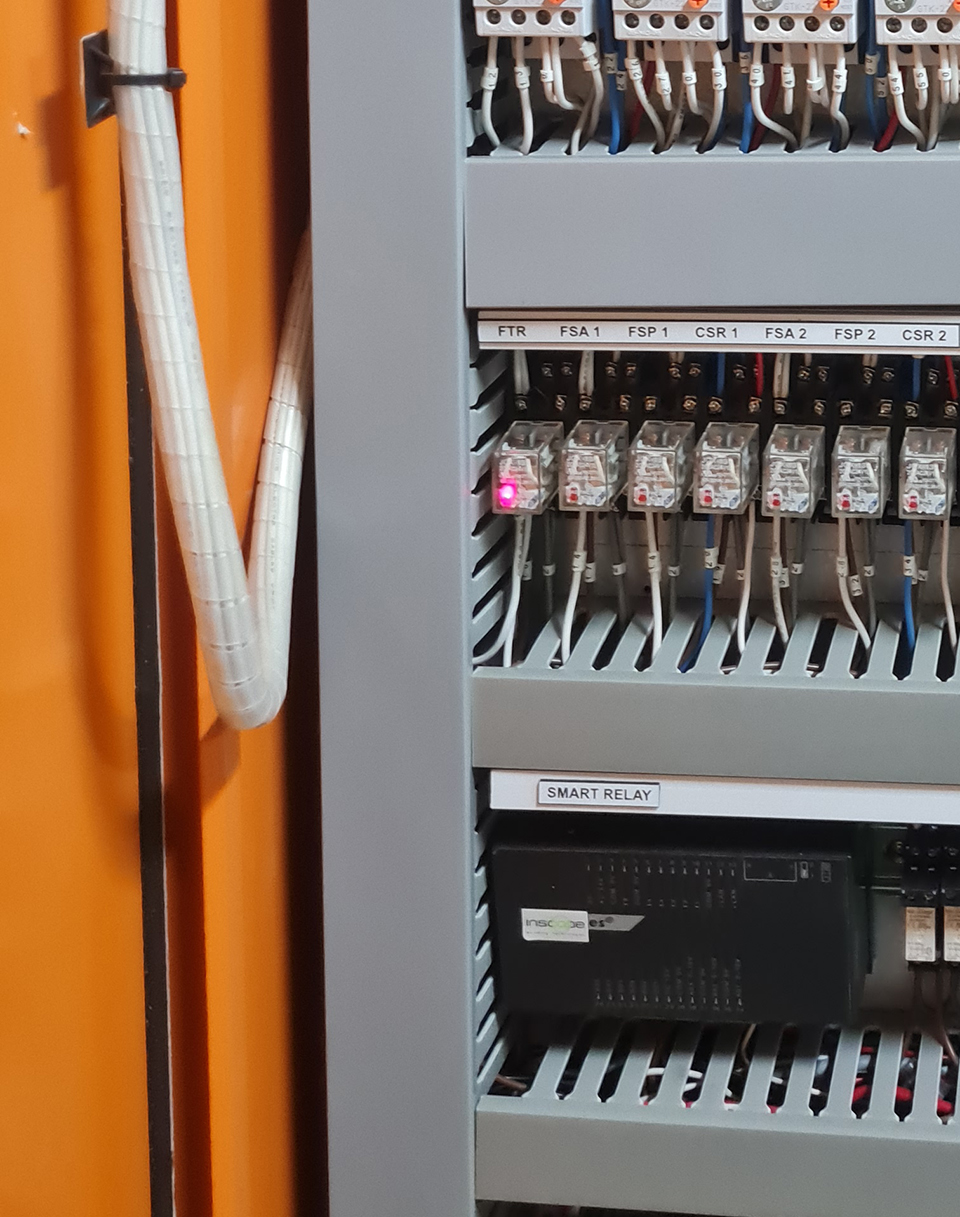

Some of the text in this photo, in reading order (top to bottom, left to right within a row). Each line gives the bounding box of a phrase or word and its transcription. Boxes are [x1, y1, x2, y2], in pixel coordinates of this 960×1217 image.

[489, 72, 496, 87] 12
[752, 67, 761, 83] 40
[835, 73, 843, 89] 44
[916, 72, 924, 86] 55
[891, 76, 900, 92] 54
[497, 326, 526, 338] FTR
[560, 326, 600, 338] FSA 1
[629, 326, 668, 338] FSP 1
[695, 327, 738, 339] CSR 1
[765, 328, 807, 340] FSA 2
[834, 328, 876, 340] FSP 2
[902, 329, 947, 341] CSR 2
[547, 787, 652, 802] SMART RELAY
